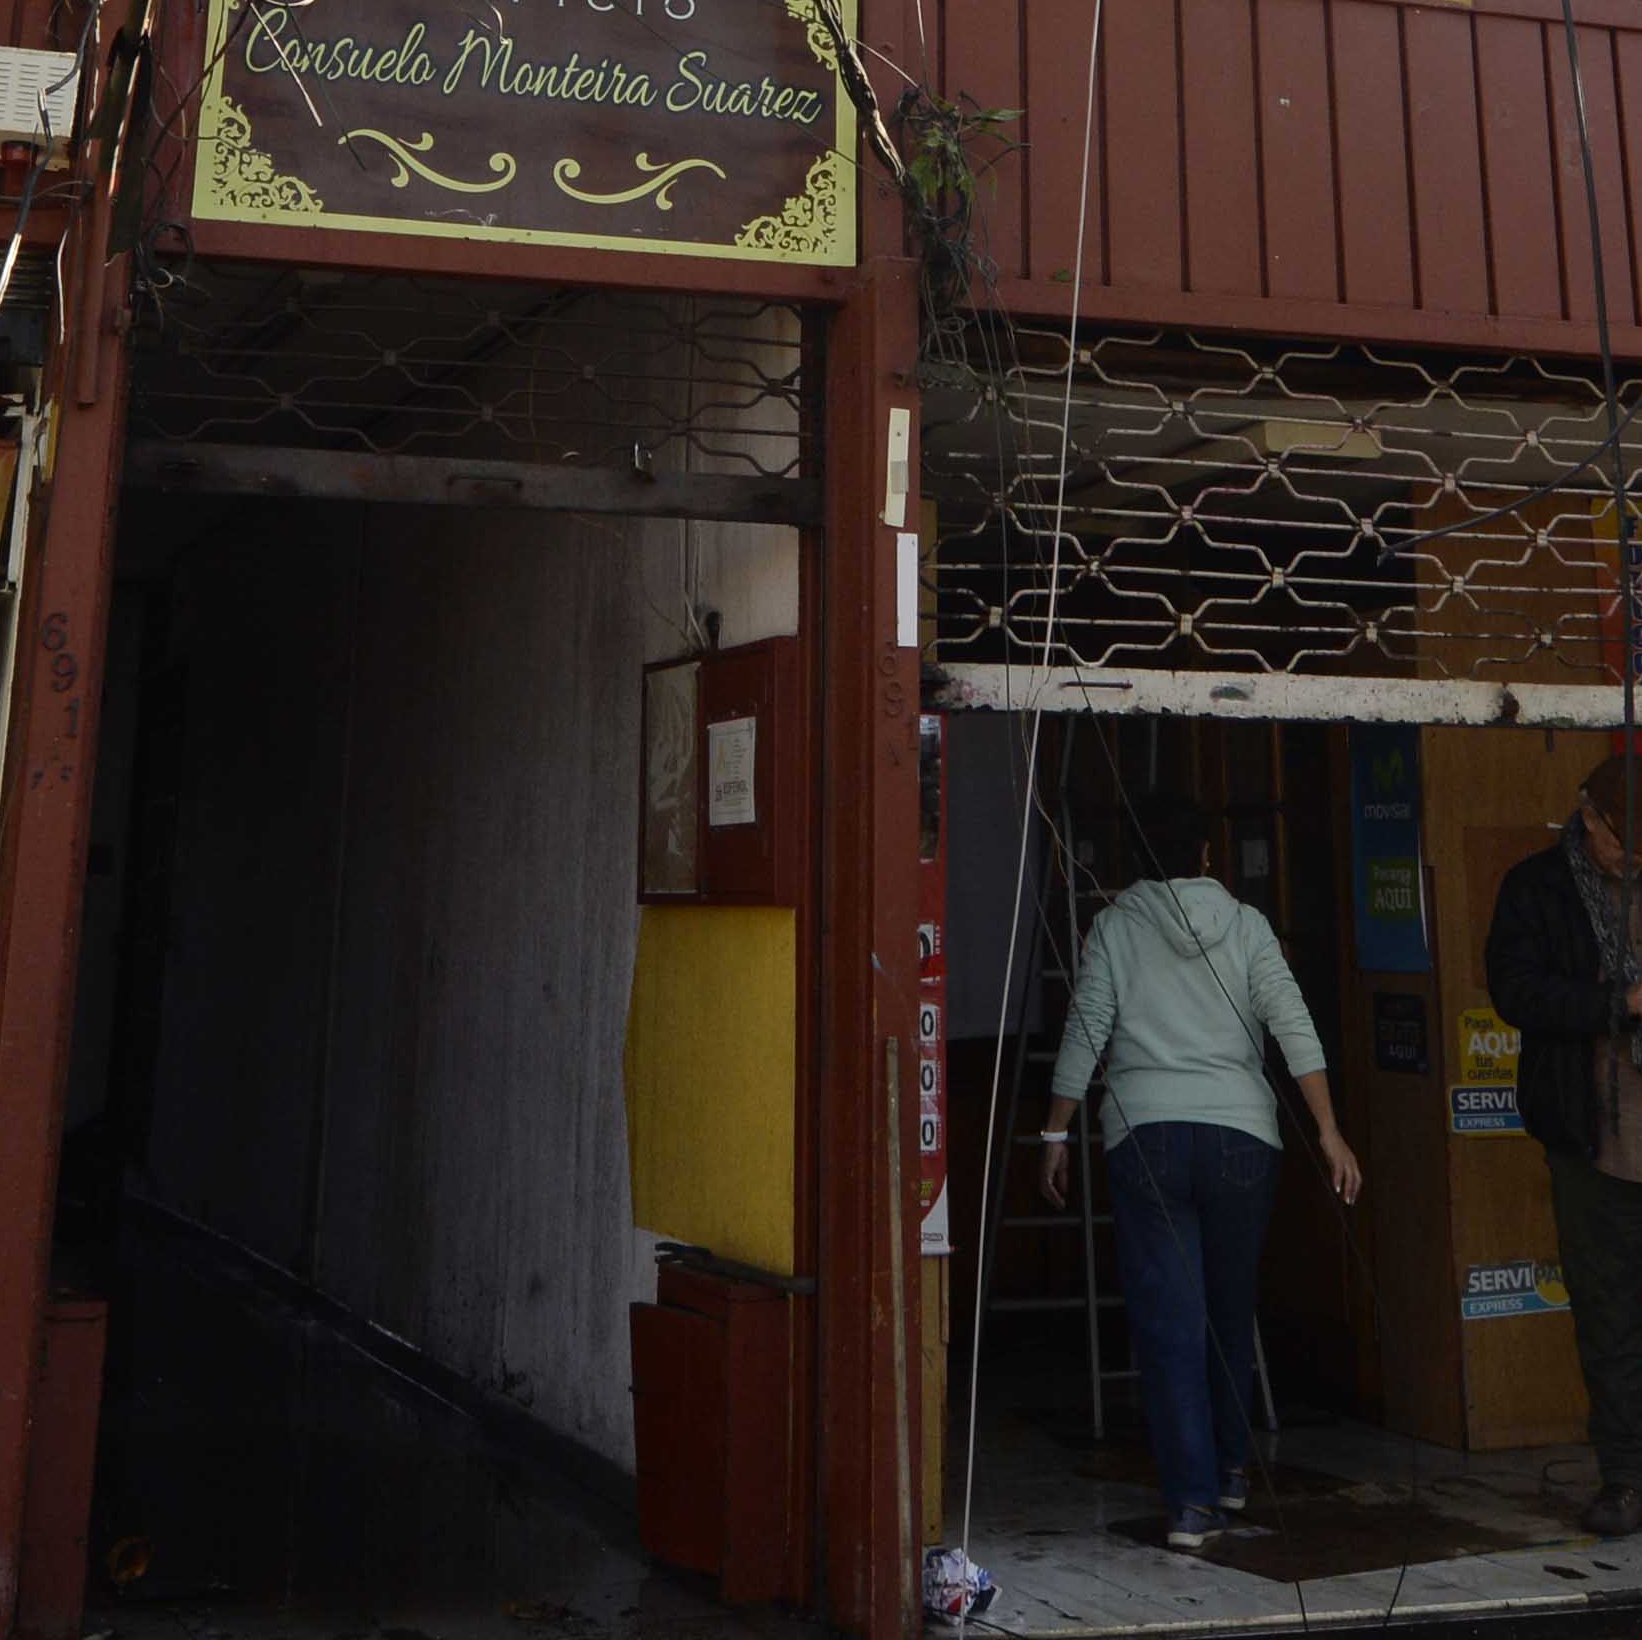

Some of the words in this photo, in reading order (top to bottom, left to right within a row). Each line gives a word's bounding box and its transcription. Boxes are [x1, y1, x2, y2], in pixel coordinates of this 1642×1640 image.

[244, 8, 437, 87] Consuelo
[442, 29, 657, 107] Monteira
[664, 52, 822, 125] Suarez
[1469, 1297, 1525, 1314] EXPRESS
